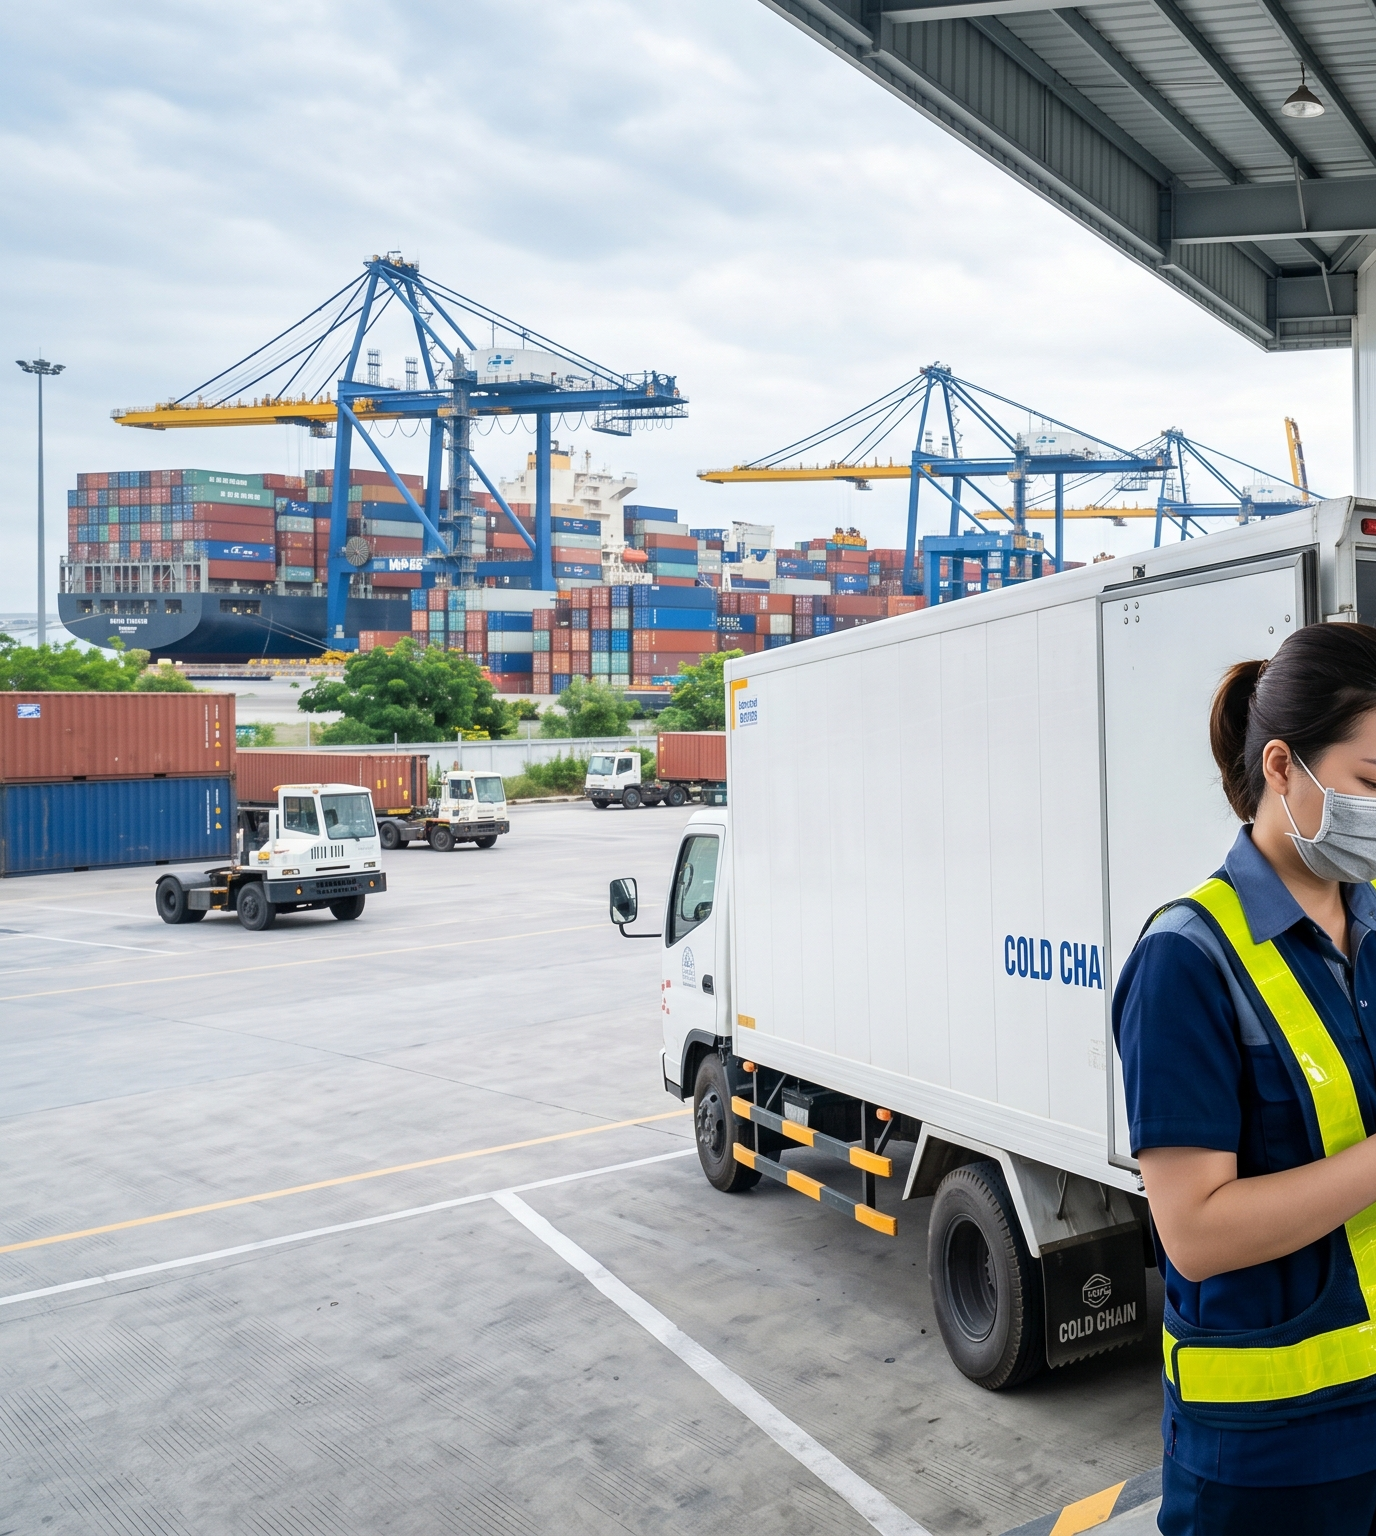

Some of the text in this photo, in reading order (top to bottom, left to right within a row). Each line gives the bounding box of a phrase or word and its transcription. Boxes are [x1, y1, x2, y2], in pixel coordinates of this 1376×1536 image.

[1004, 934, 1106, 990] COLD CHA
[1059, 1301, 1136, 1343] COLD CHAIN
